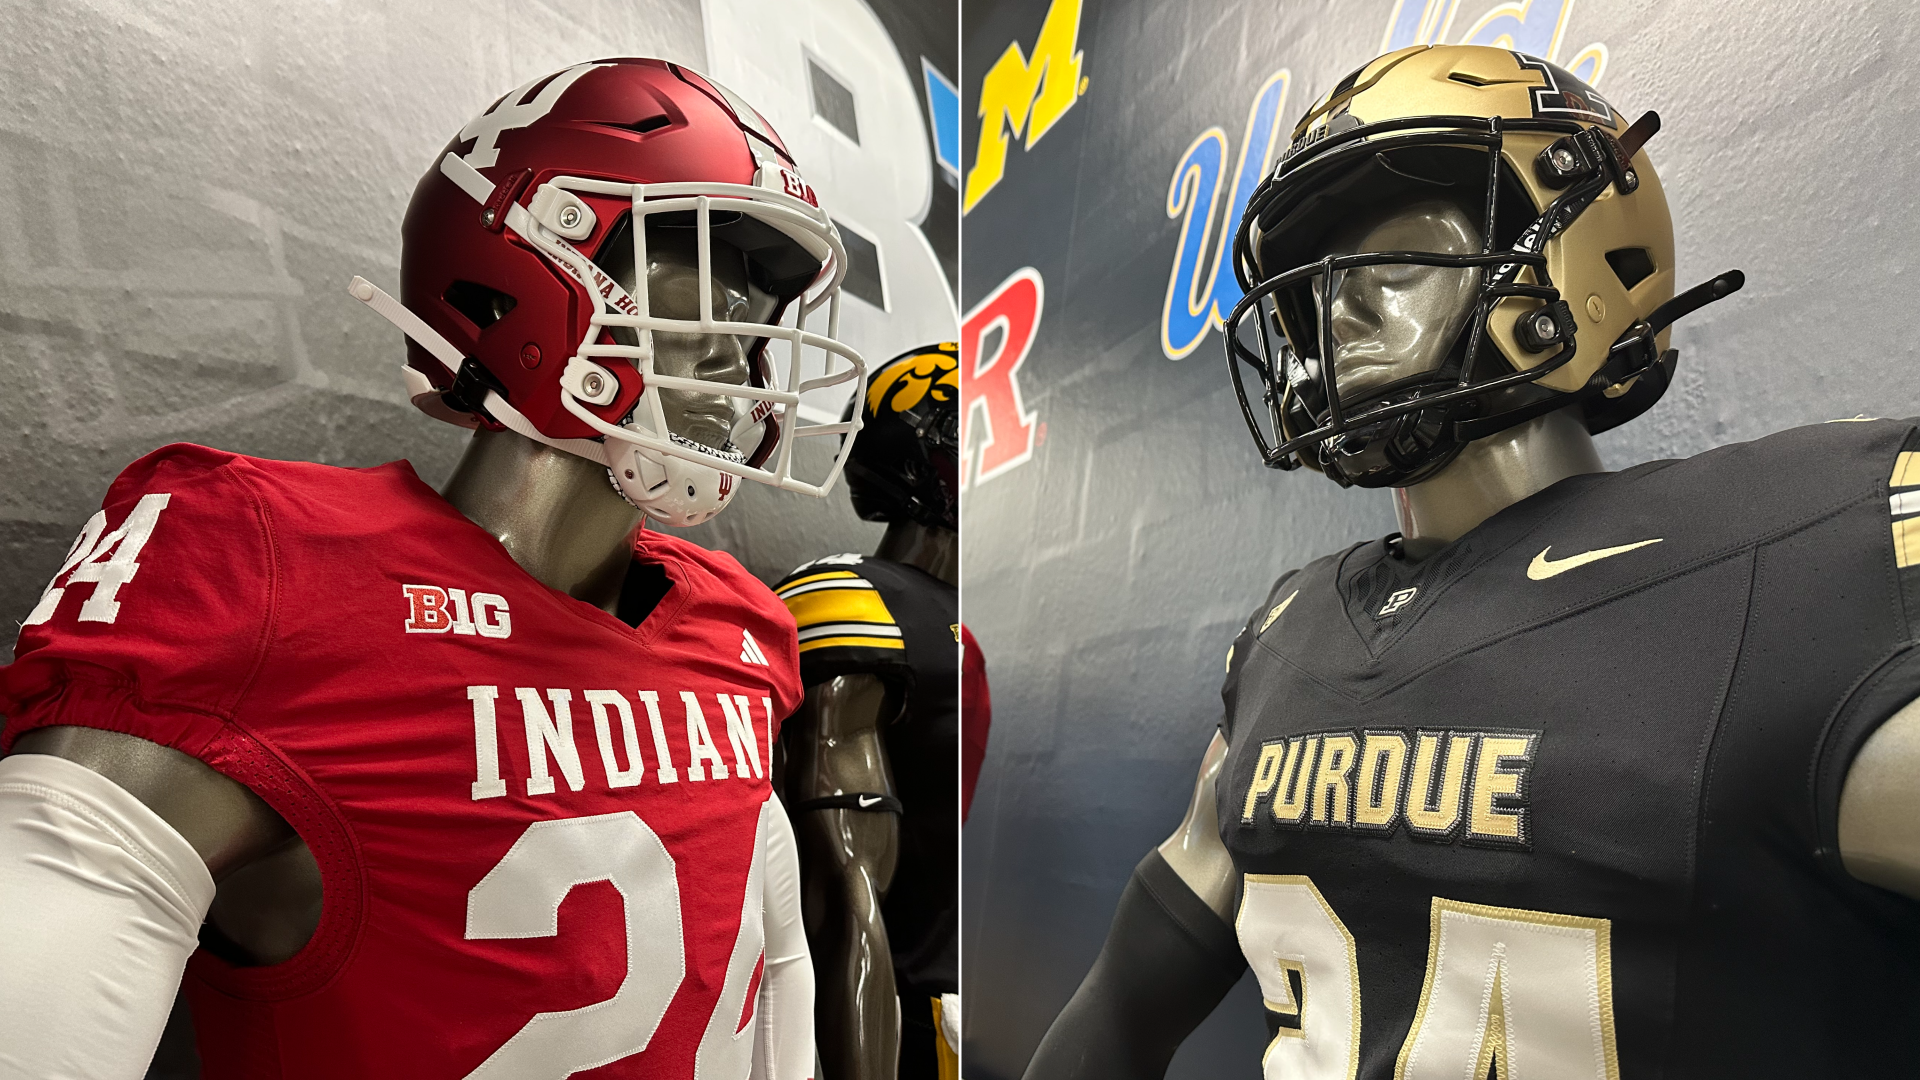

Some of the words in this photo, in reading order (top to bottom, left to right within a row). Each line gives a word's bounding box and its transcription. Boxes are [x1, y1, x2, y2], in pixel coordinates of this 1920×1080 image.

[20, 493, 171, 625] 24
[467, 683, 773, 801] INDIAN
[1240, 727, 1542, 850] PURDUE
[1235, 873, 1620, 1080] 24
